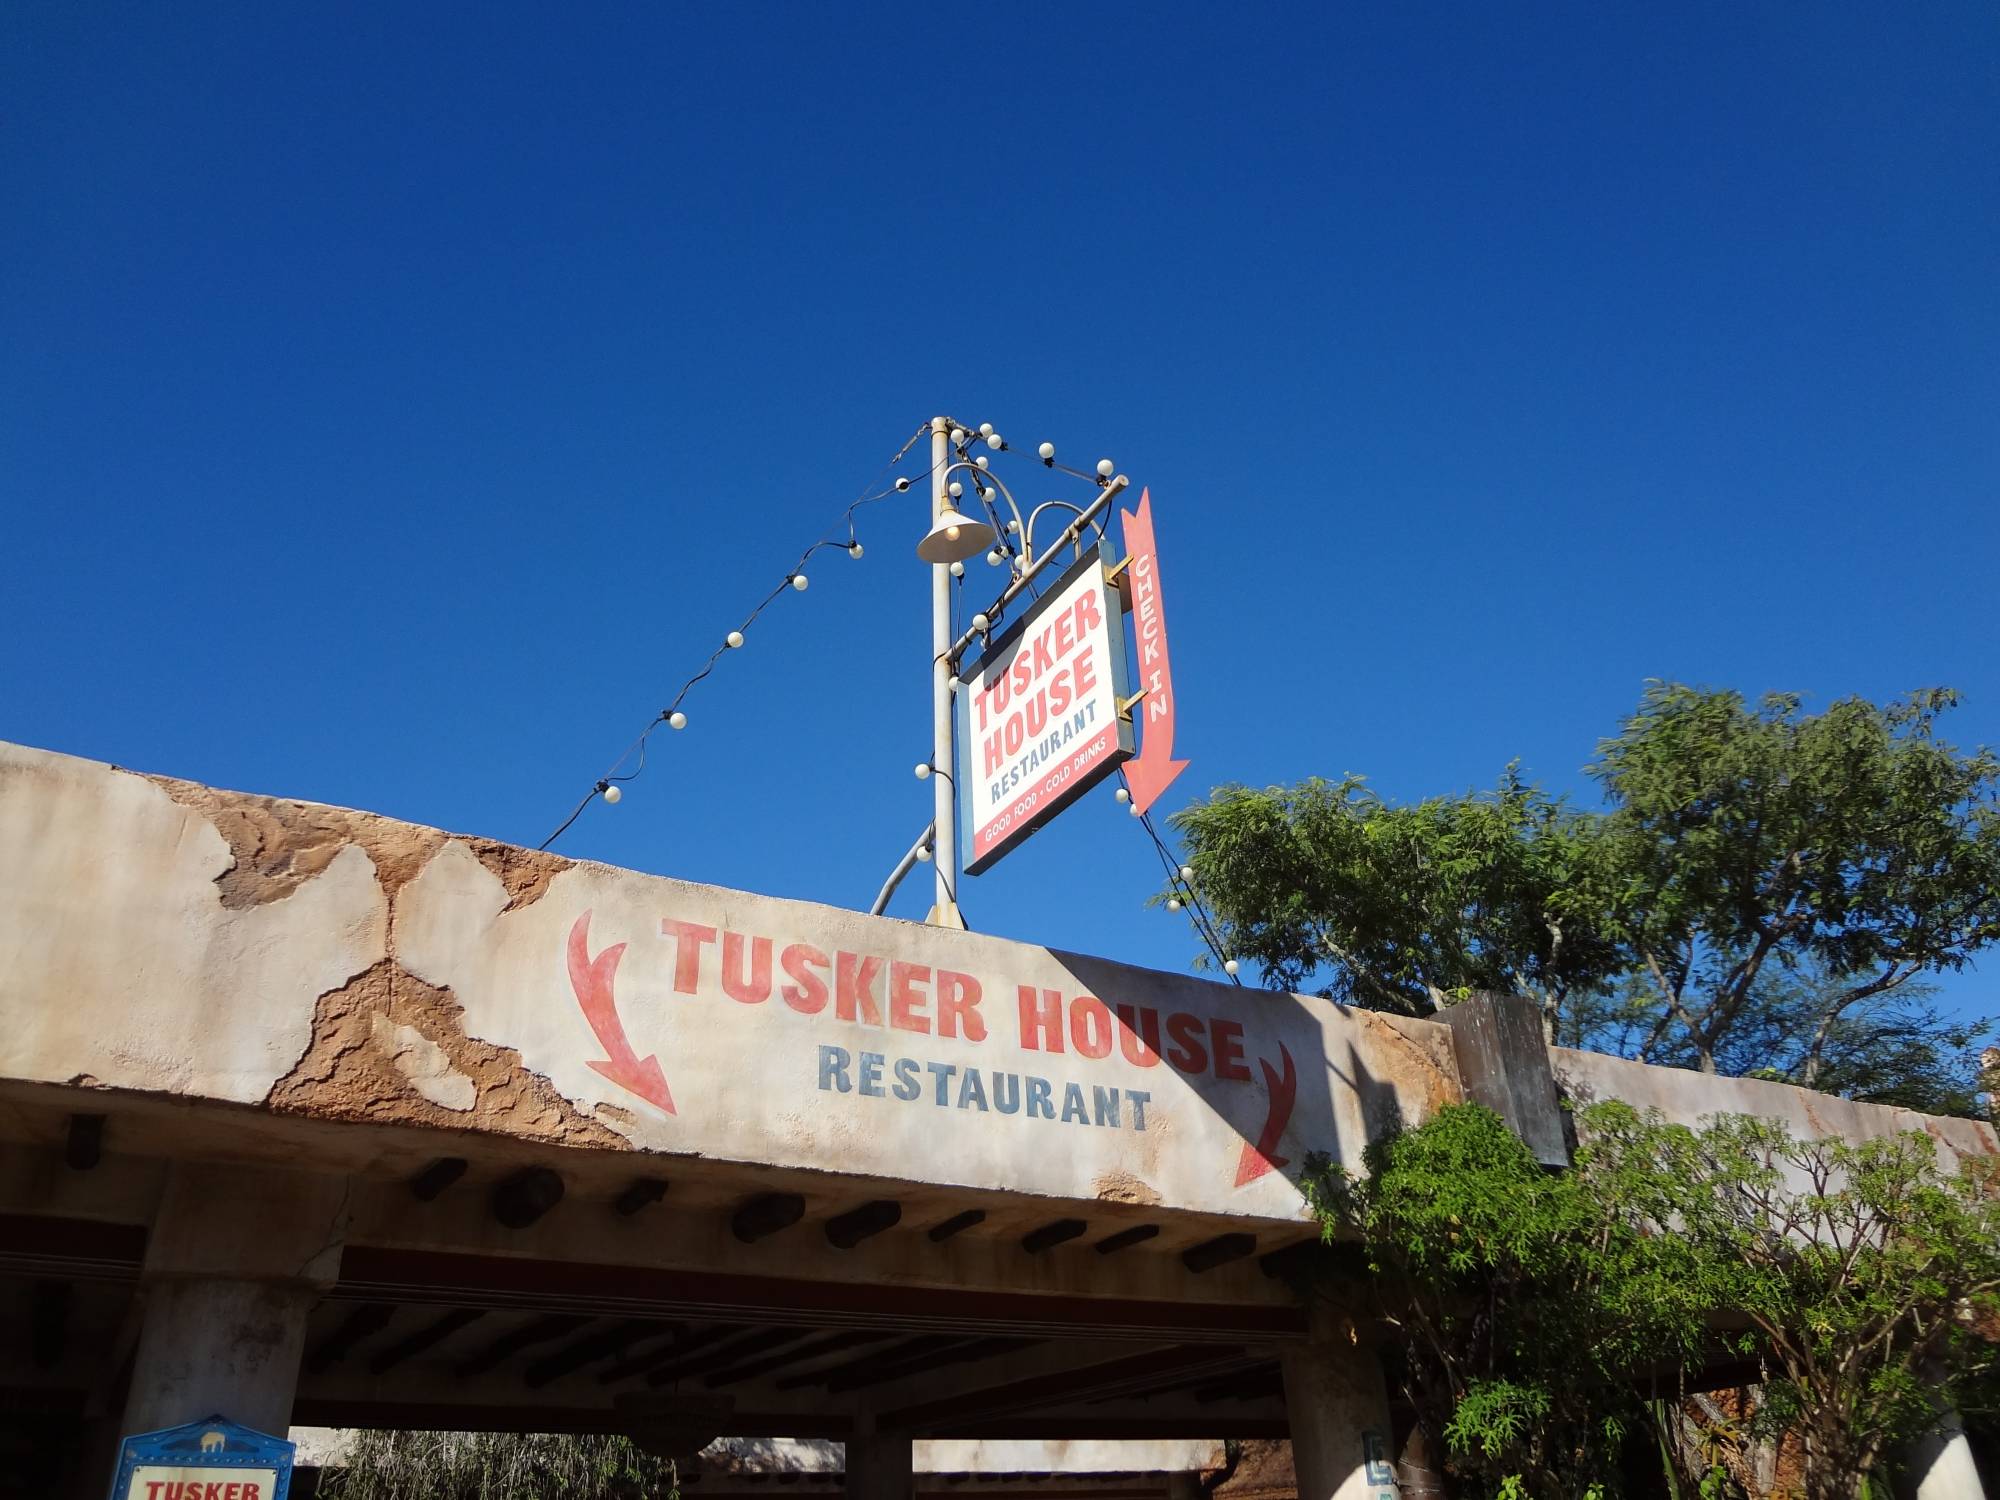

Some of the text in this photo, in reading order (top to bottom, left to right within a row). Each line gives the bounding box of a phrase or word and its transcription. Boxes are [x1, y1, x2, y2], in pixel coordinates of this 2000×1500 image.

[975, 588, 1101, 732] TUSKER
[1135, 554, 1167, 723] CHECK IN
[984, 644, 1097, 780] HOUSE
[991, 698, 1096, 805] RESTAURANT
[985, 736, 1106, 842] GOOD FOOD COLD DRINKS
[662, 918, 1253, 1081] TUSKER HOUSE
[817, 1044, 1152, 1132] RESTAURANT
[146, 1481, 260, 1500] TUSKER
